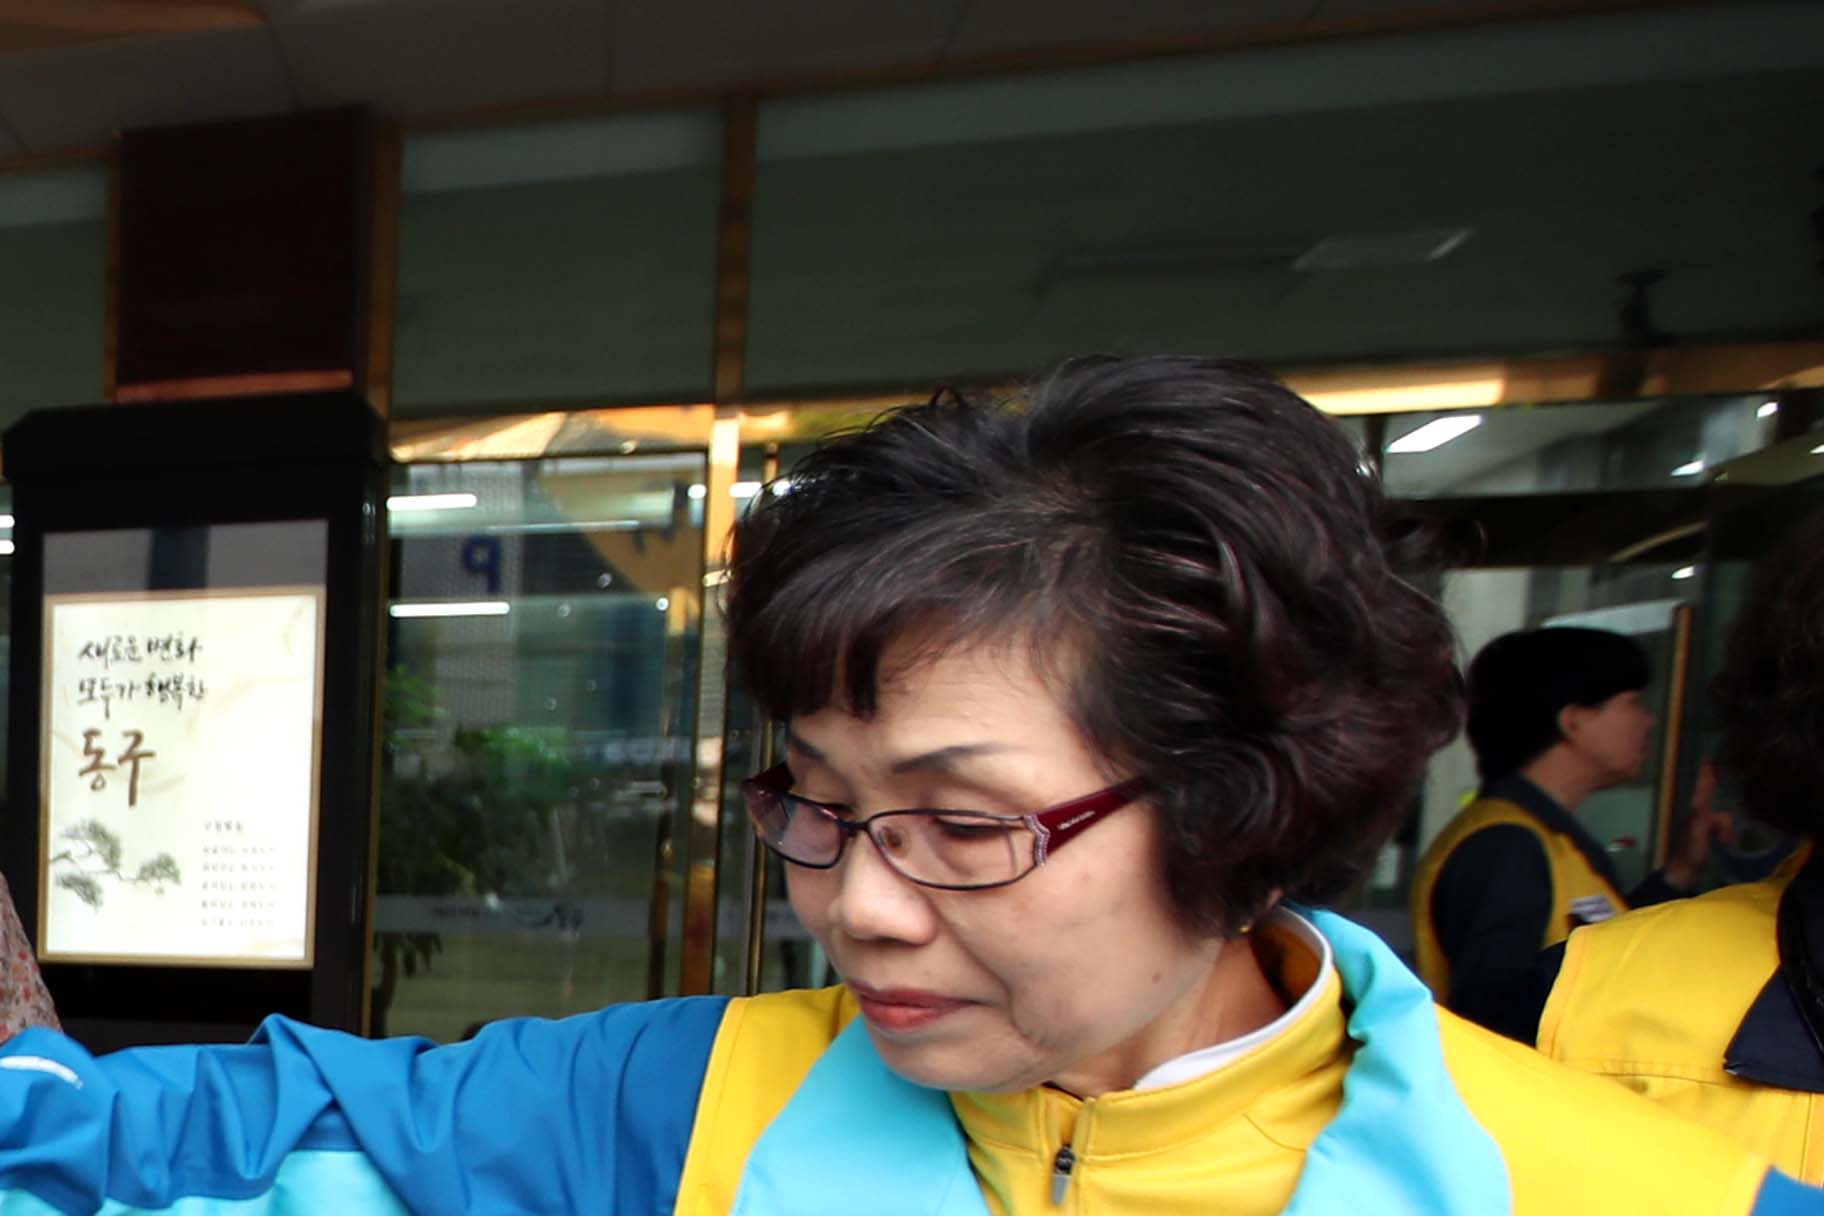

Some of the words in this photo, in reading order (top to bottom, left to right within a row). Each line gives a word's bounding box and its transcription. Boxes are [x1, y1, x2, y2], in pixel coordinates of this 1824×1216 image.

[77, 634, 142, 670] 새로운
[146, 630, 203, 662] 변화
[76, 676, 141, 720] 모두가
[144, 671, 206, 713] 행복한
[78, 726, 157, 808] 동구
